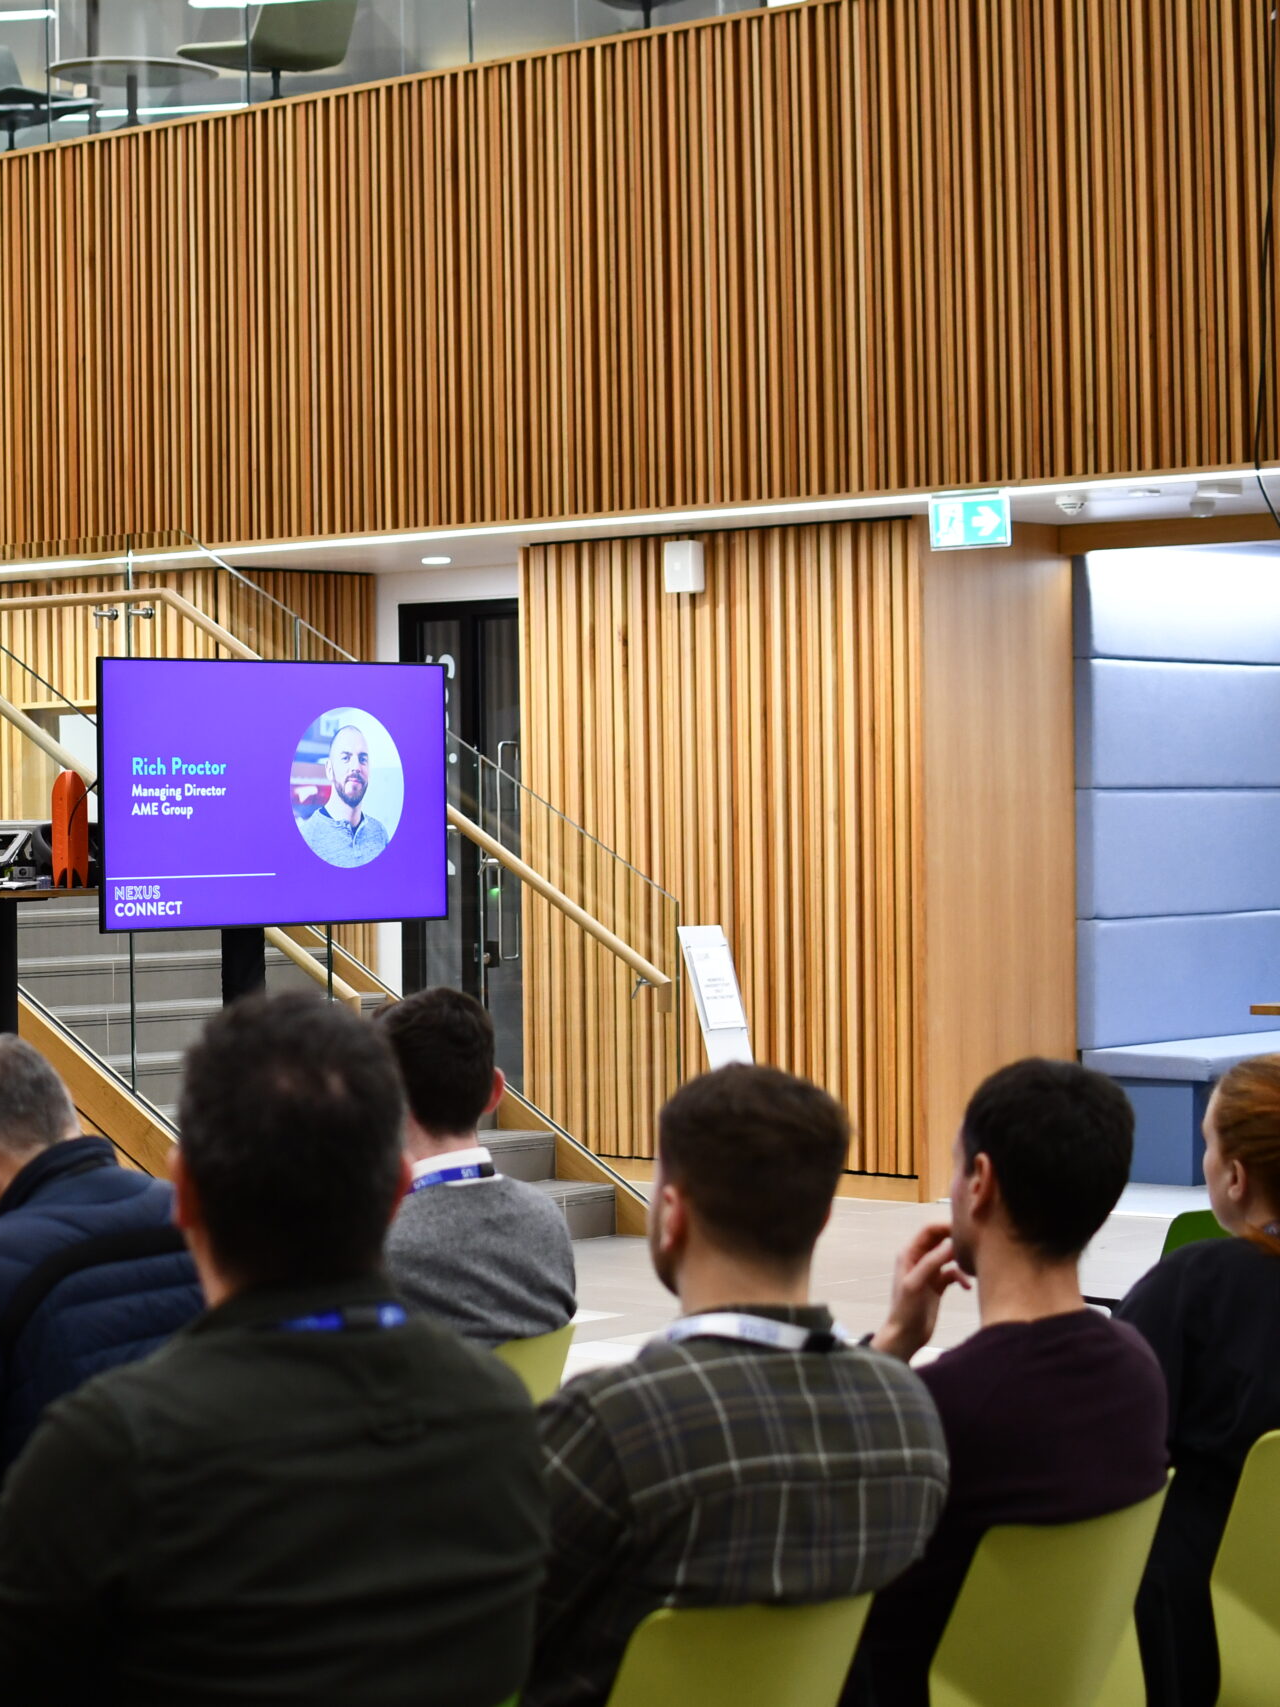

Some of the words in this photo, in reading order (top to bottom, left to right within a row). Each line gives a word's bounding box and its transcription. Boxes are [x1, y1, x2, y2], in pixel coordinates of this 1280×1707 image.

[132, 757, 166, 775] Rich
[172, 757, 227, 775] Proctor
[131, 784, 182, 801] Managing
[184, 784, 226, 797] Director
[131, 802, 158, 816] AME
[161, 803, 193, 819] Group
[114, 885, 161, 900] NEXUS
[114, 901, 182, 917] CONNECT
